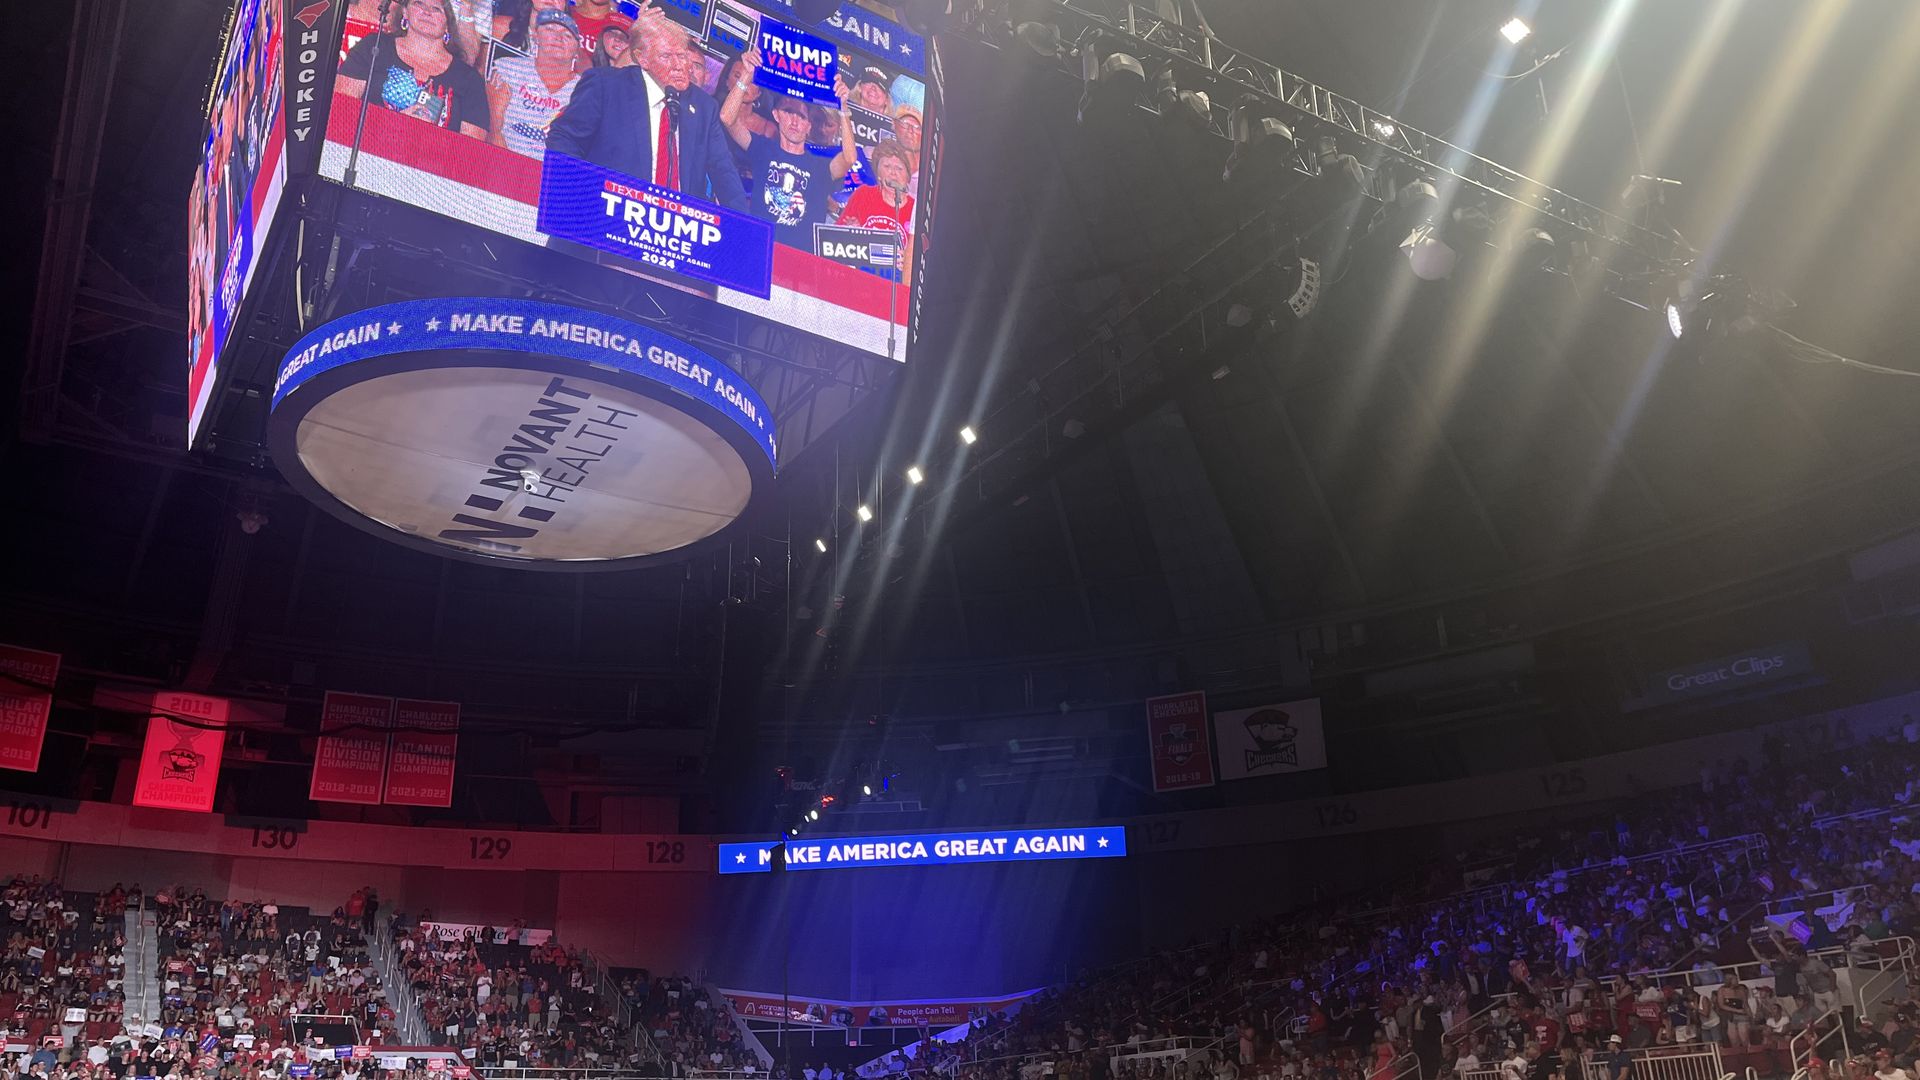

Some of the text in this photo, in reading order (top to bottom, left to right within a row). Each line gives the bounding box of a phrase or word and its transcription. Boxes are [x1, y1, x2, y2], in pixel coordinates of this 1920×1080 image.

[711, 27, 746, 50] LUE
[826, 9, 890, 50] GAIN
[762, 33, 832, 67] TRUMP
[767, 52, 827, 81] VANCE
[294, 29, 319, 143] HOCKEY
[787, 88, 805, 98] 2024
[850, 121, 878, 142] ACK
[611, 182, 716, 223] TEXT NC TO 88022
[601, 191, 722, 246] TRUMP
[606, 233, 627, 244] MAKE
[628, 239, 661, 254] AMERICA
[662, 249, 684, 261] GREAT
[627, 224, 692, 255] VANCE
[641, 251, 675, 270] 2024
[822, 241, 868, 261] BACK
[281, 322, 380, 385] GREAT AGAIN
[450, 314, 757, 423] MAKE AMERICA GREAT AGAIN
[480, 377, 592, 491] NOVANT
[529, 405, 638, 502] HEALTH
[1667, 656, 1784, 690] Great Clips
[170, 697, 213, 715] 2019
[329, 704, 387, 717] CHARLOTTE
[399, 710, 456, 722] CHARLOTTE
[322, 747, 380, 762] DIVISION
[324, 736, 381, 751] ATLANTIC
[396, 742, 451, 755] ATLANTIC
[321, 759, 380, 772] CHAMPIONS
[393, 764, 449, 776] CHAMPIONS
[395, 752, 450, 766] DIVISION
[142, 790, 207, 805] CHAMPIONS
[391, 786, 447, 799] 2021-2022
[1315, 802, 1358, 829] 126
[251, 824, 298, 849] 130
[1143, 819, 1183, 845] 127
[470, 837, 511, 859] 129
[645, 841, 685, 864] 128
[826, 842, 928, 861] AMERICA
[934, 838, 1007, 857] GREAT
[1013, 835, 1085, 854] AGAIN
[432, 923, 508, 940] Rose Cluter
[890, 1017, 912, 1025] When
[897, 1006, 955, 1016] People Can Tell
